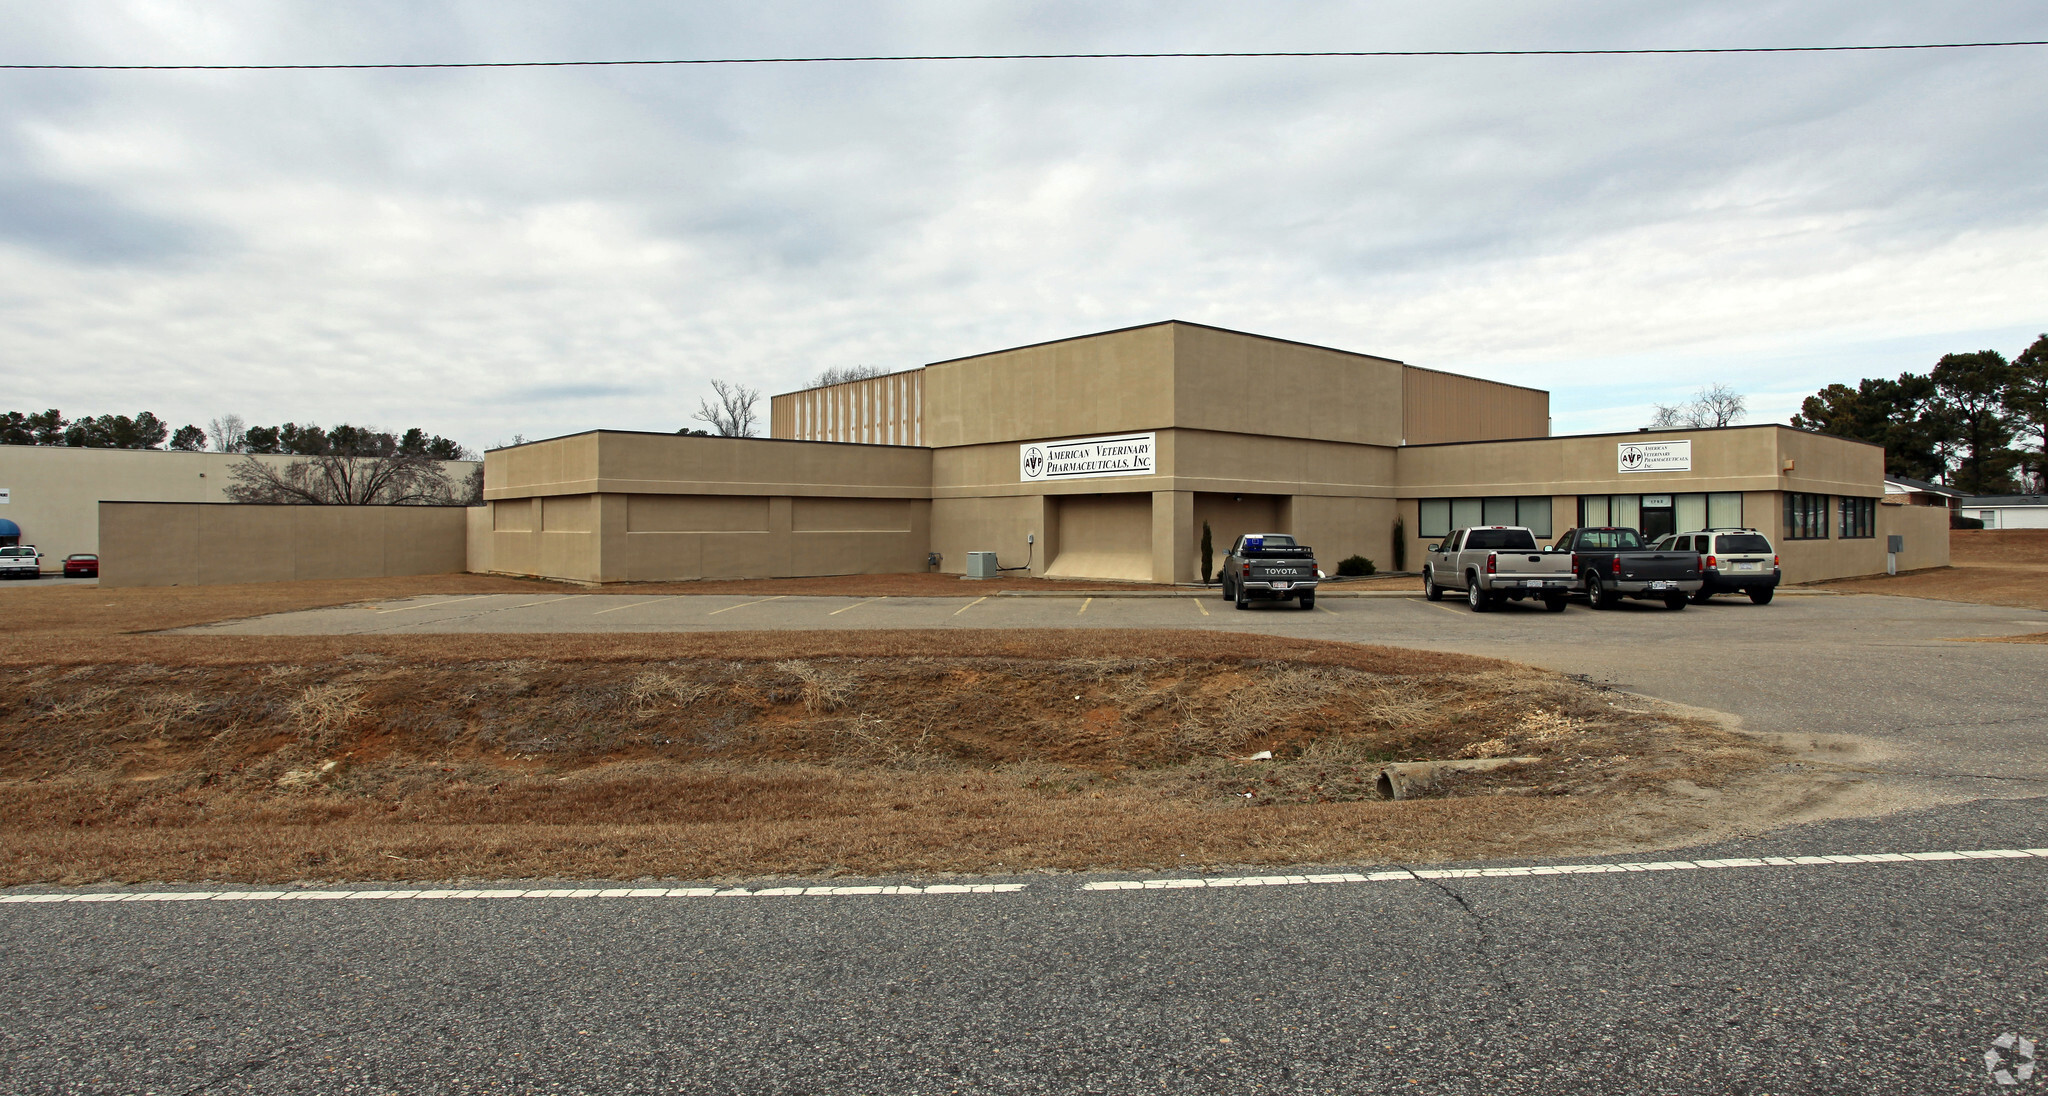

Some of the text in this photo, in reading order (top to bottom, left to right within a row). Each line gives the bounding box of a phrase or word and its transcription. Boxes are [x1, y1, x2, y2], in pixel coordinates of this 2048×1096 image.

[1047, 444, 1150, 461] AMERICAN VETERINARY
[1133, 455, 1151, 468] INC.
